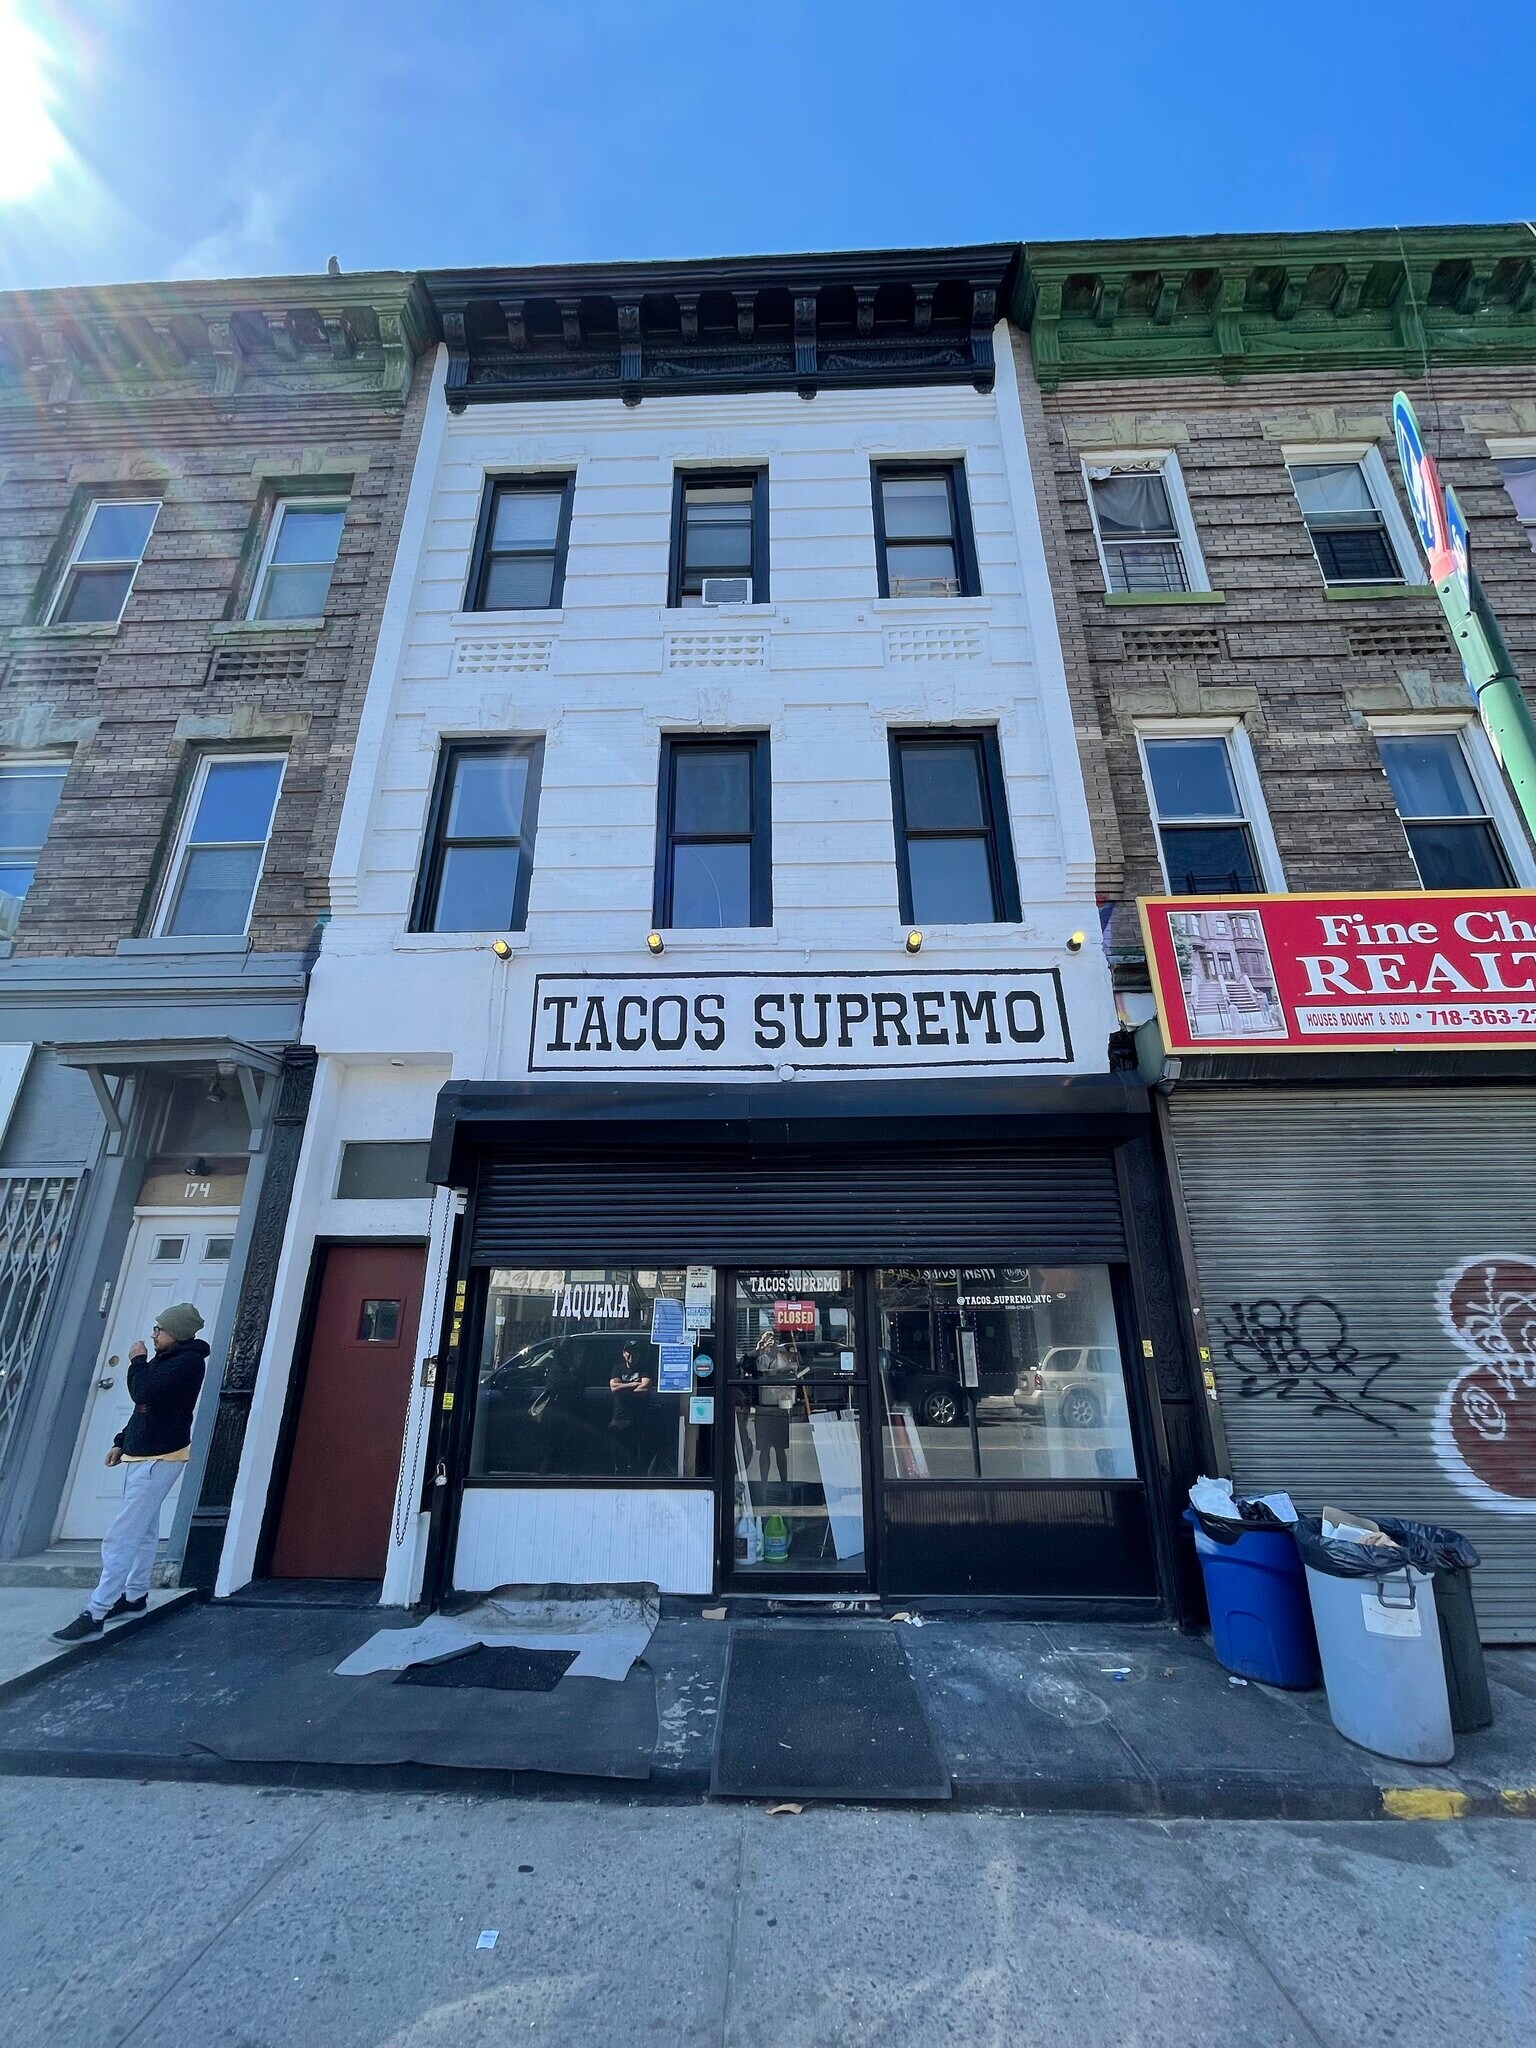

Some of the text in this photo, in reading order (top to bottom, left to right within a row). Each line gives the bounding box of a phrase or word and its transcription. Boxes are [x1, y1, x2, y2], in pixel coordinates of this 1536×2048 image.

[1315, 910, 1536, 946] Fine Ch
[543, 990, 1046, 1051] TACOS SUPREMO
[1306, 1009, 1536, 1026] HOUSES BOUGHT & SOLD 718-363-2
[184, 1182, 211, 1198] 174
[750, 1276, 840, 1292] TACOS SUPREMO
[551, 1283, 630, 1321] TAQUERIA
[777, 1311, 814, 1324] CLOSED
